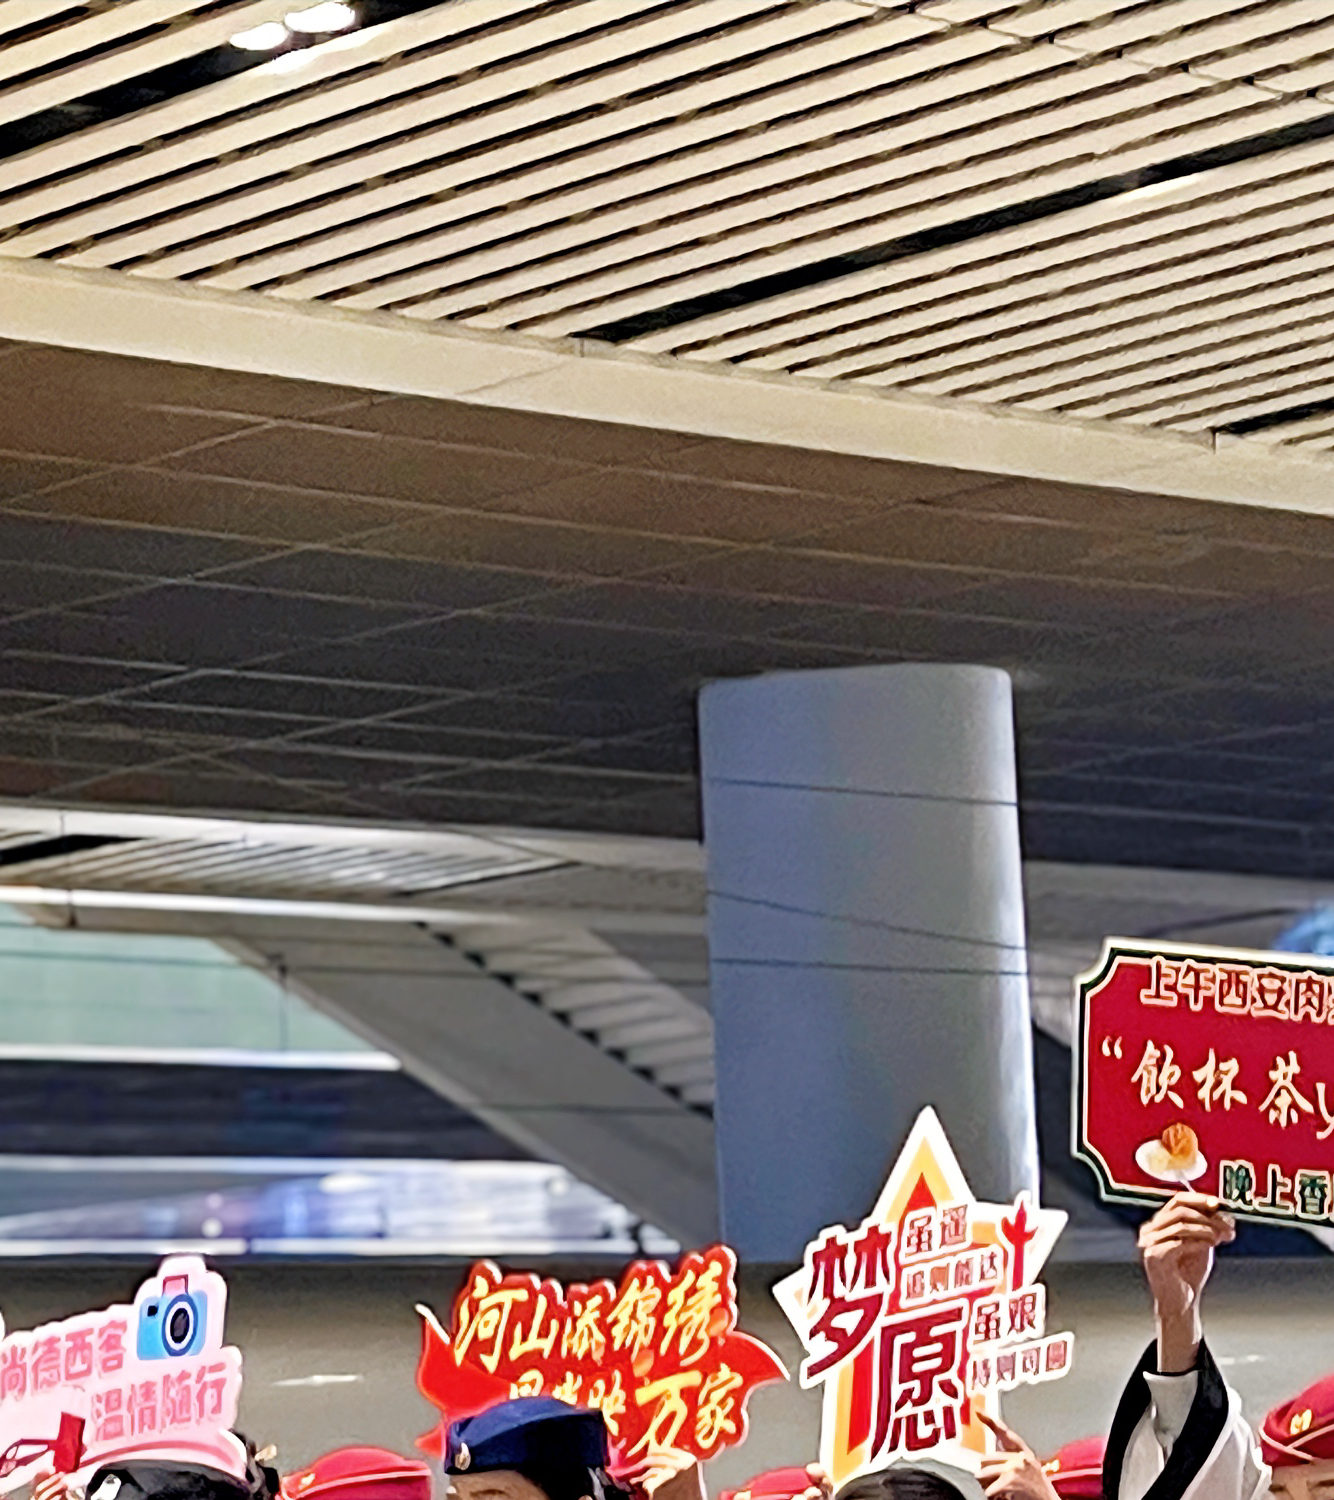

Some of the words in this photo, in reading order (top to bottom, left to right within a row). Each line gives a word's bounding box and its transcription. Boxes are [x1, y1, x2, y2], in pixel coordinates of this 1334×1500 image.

[453, 1260, 723, 1374] 河山添锦绣
[91, 1362, 227, 1442] 温情随行
